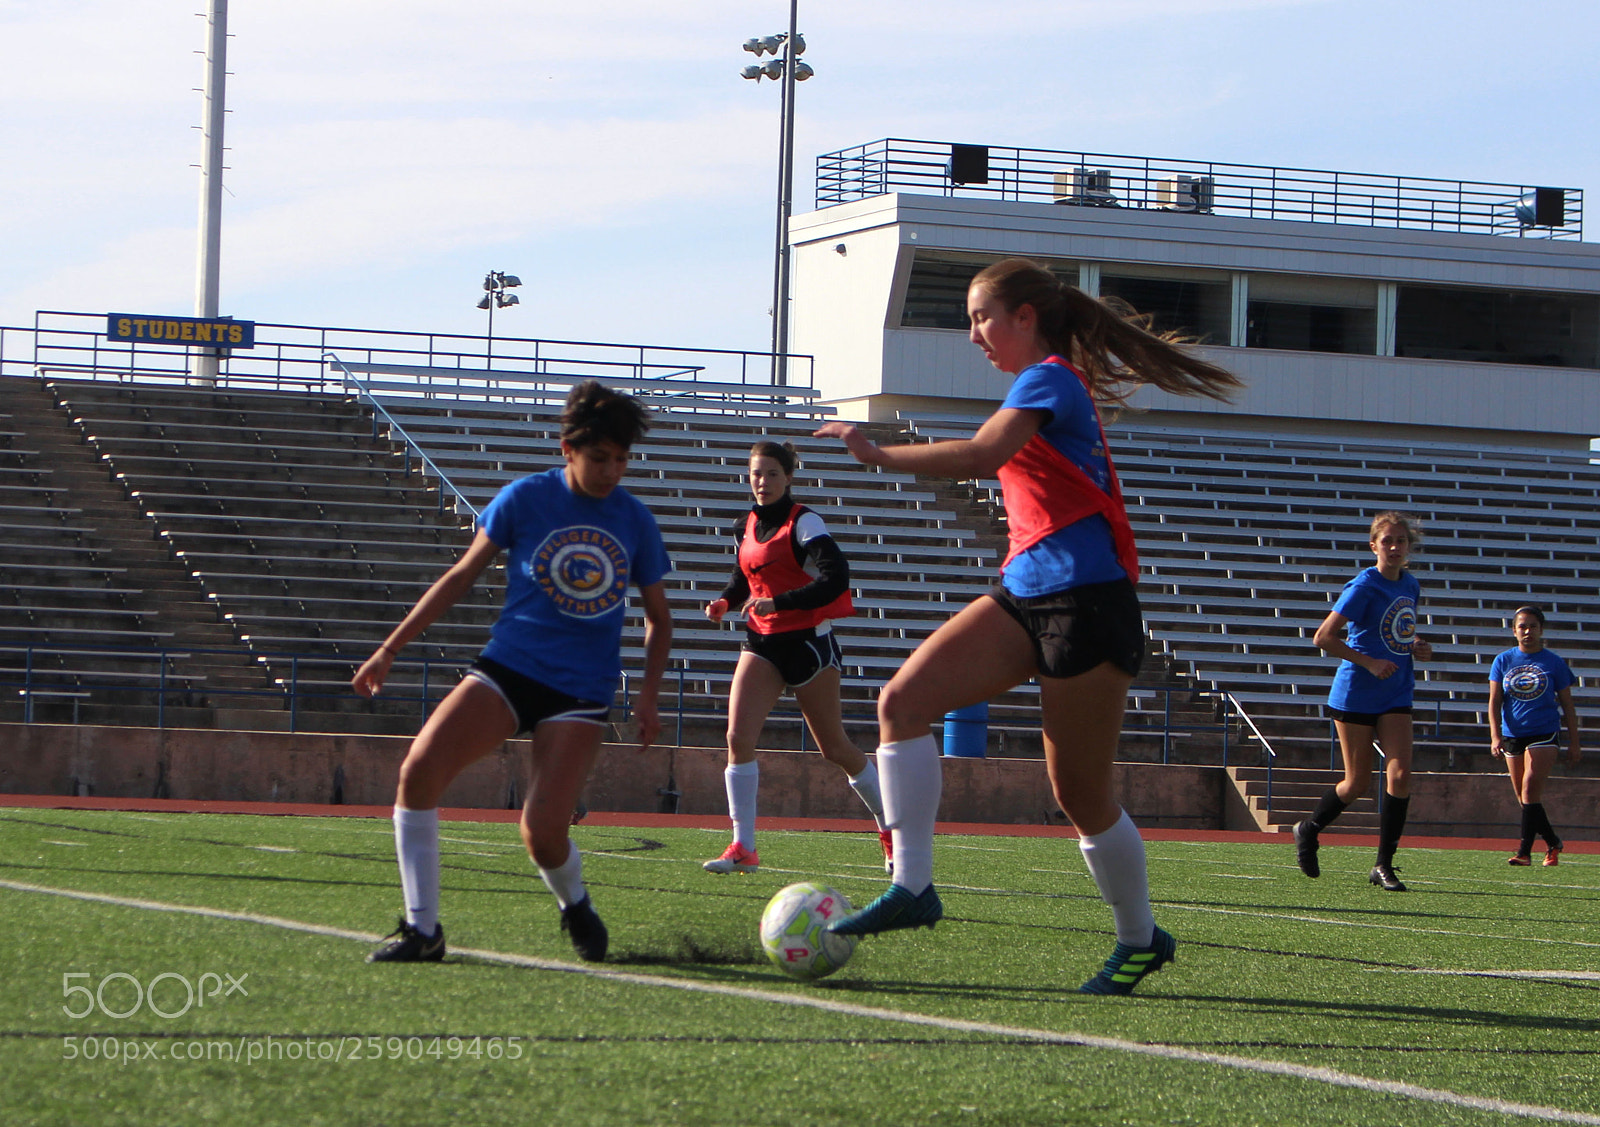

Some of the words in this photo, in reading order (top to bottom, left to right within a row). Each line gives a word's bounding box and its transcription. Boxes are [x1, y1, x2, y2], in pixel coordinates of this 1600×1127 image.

[117, 318, 243, 343] STUDENTS
[538, 530, 628, 576] PFLUGERVILLE
[539, 577, 618, 613] PANTHERS
